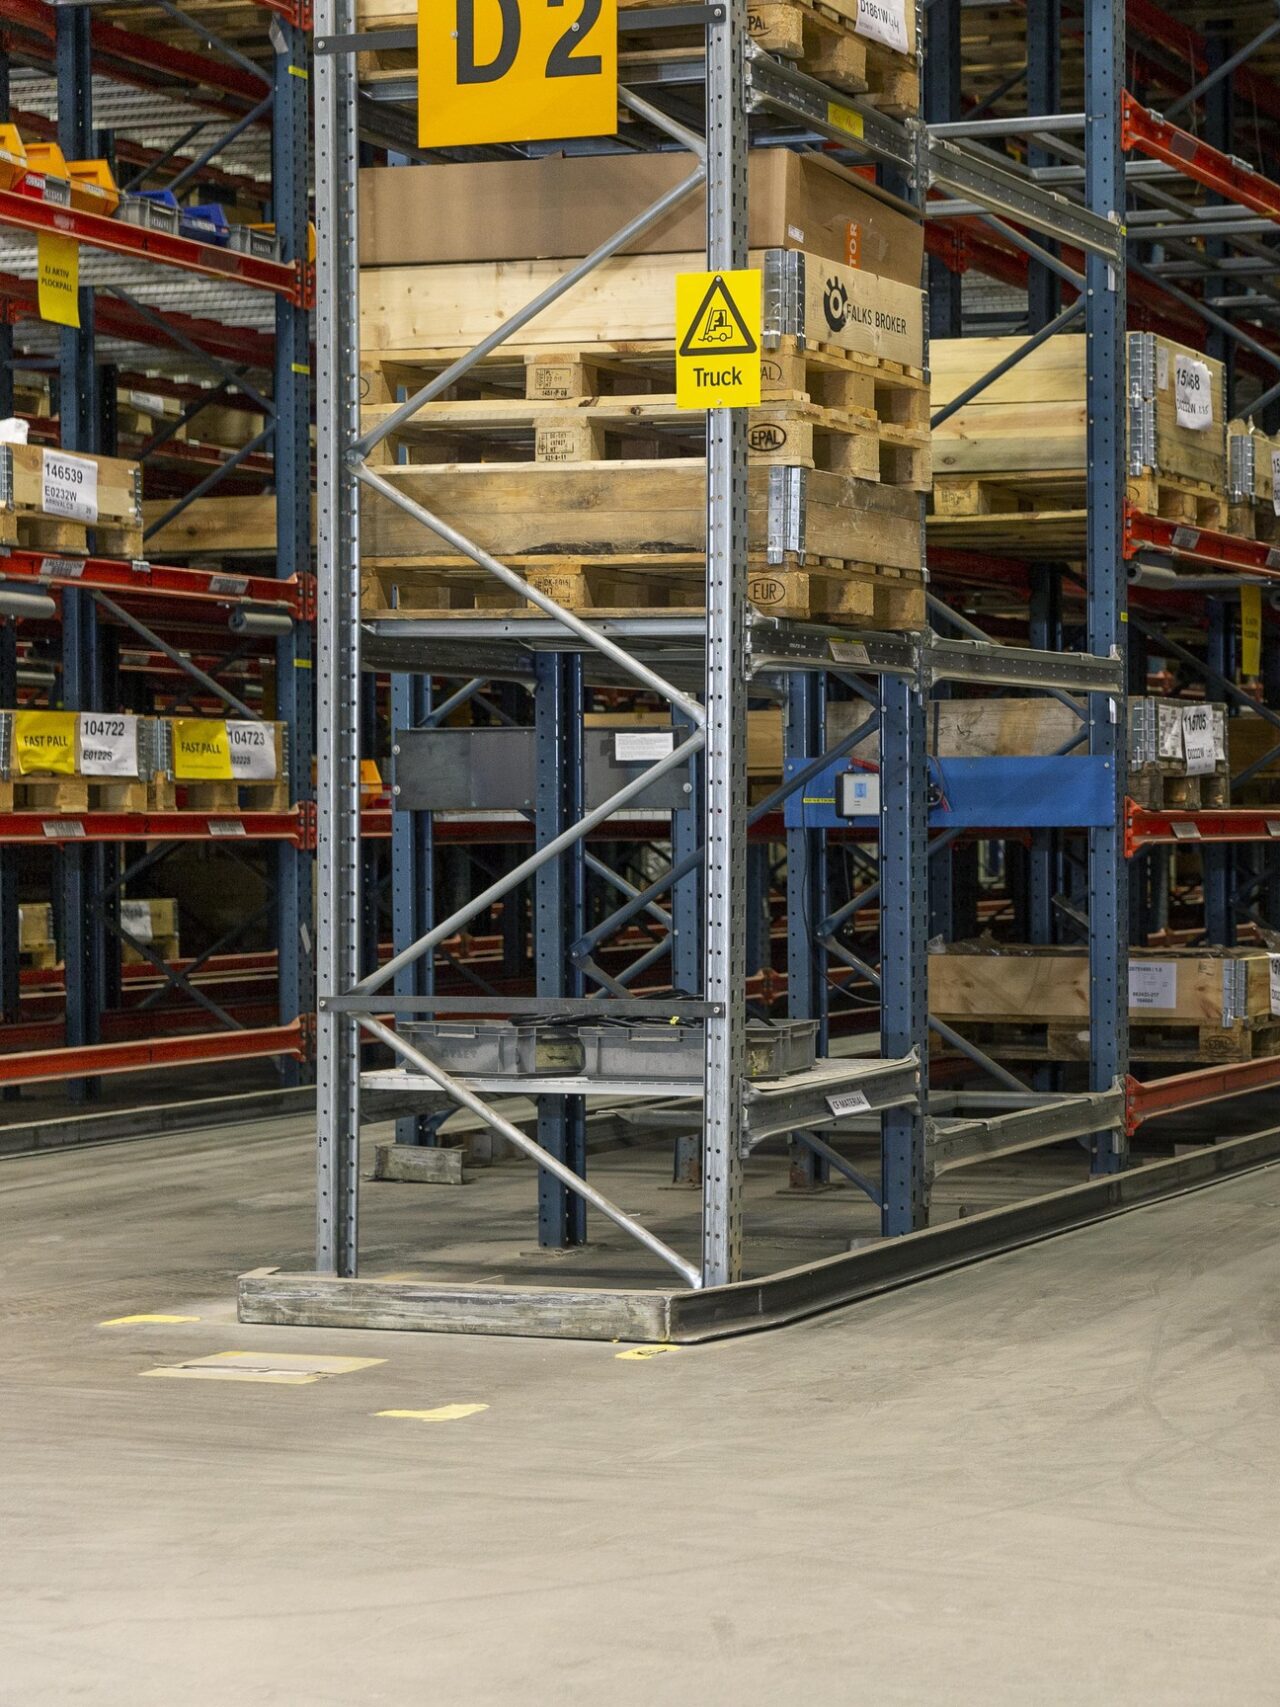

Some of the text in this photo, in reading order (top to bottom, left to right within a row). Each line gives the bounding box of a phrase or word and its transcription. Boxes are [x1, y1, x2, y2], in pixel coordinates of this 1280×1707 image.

[749, 15, 768, 31] PAL
[846, 303, 908, 336] FALKS BROKER
[693, 366, 743, 388] Truck
[761, 366, 776, 381] AL
[751, 430, 780, 446] EPAL
[44, 462, 84, 485] 146539
[44, 485, 78, 503] E0232W
[752, 583, 777, 600] EUR
[84, 720, 126, 737] 104722
[24, 735, 68, 747] FAST PALL
[228, 730, 266, 747] 104723
[181, 742, 222, 754] FAST PALL
